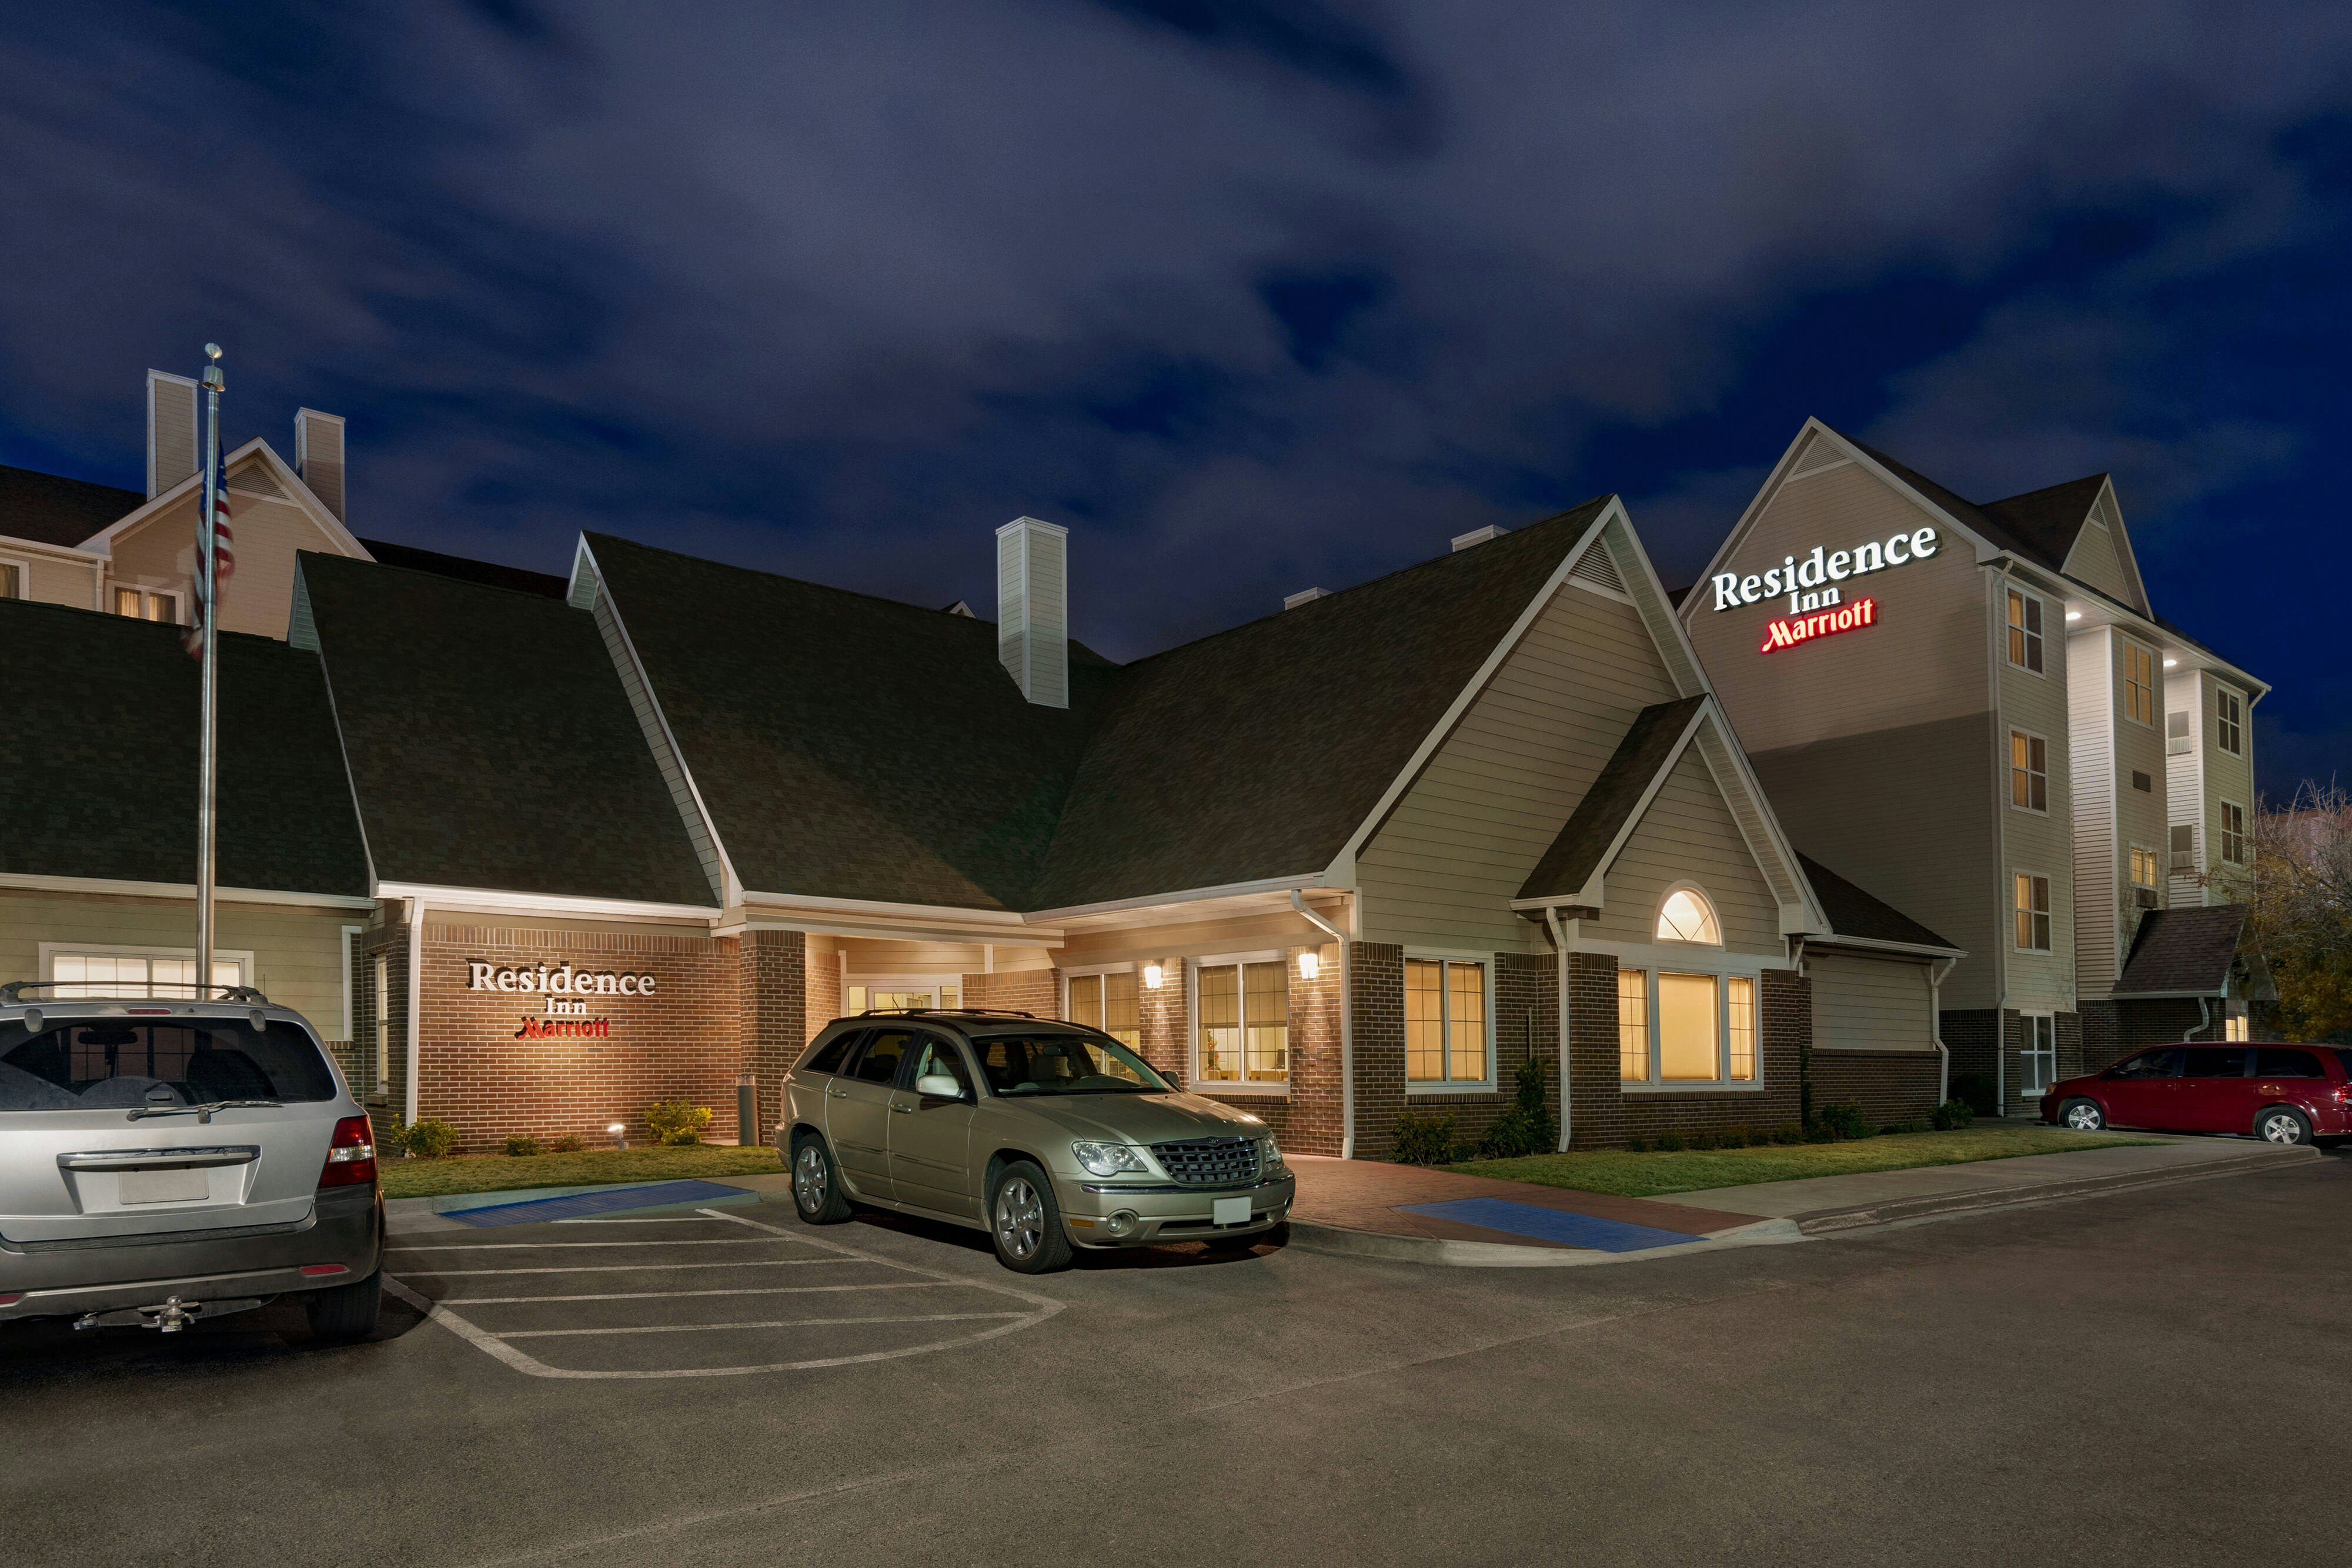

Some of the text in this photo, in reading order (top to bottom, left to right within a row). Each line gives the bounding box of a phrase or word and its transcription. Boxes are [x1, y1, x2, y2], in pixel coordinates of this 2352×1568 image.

[1712, 527, 1936, 611] Residence
[1790, 587, 1840, 614] Inn
[1762, 598, 1874, 652] Marriott
[469, 964, 656, 995] Residence
[545, 997, 587, 1015] Inn
[516, 1017, 609, 1040] Marriott
